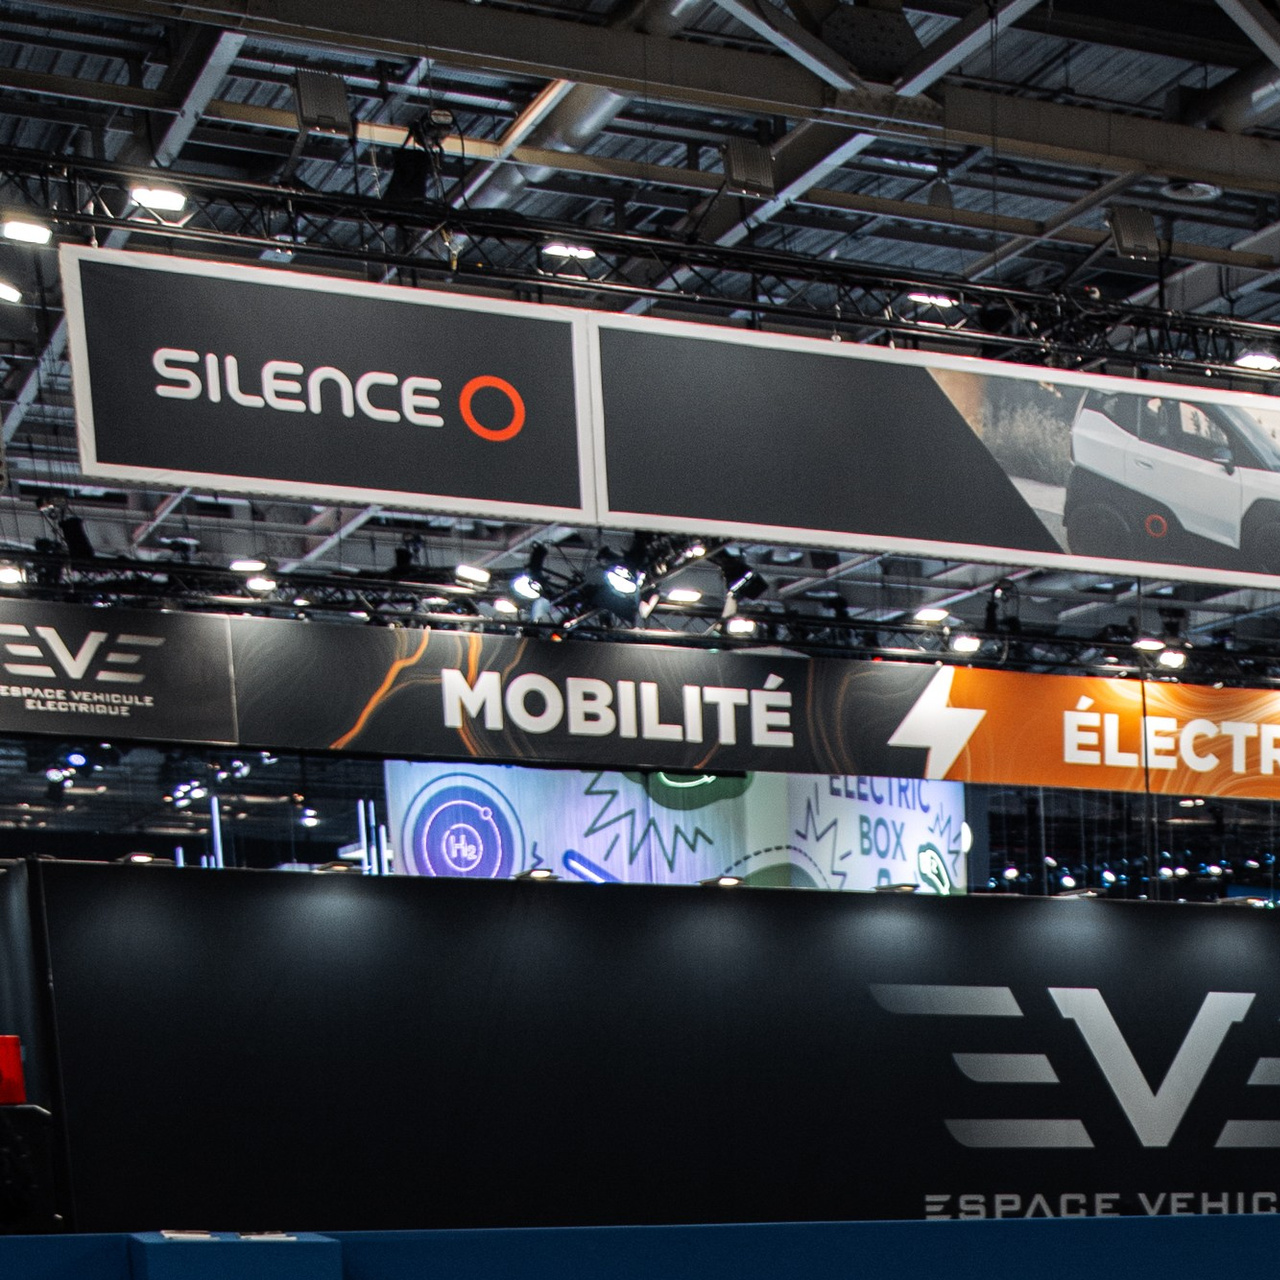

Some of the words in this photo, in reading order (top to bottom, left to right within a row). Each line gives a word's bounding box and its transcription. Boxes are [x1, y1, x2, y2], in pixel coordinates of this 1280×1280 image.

[152, 347, 444, 428] SILENCE
[0, 685, 67, 700] ESPACE
[69, 689, 154, 707] VEHICULE
[25, 699, 131, 717] ELECTRIQUE
[441, 668, 794, 747] MOBILITÉ
[859, 814, 907, 861] BOX
[925, 1192, 1120, 1221] ESPACE
